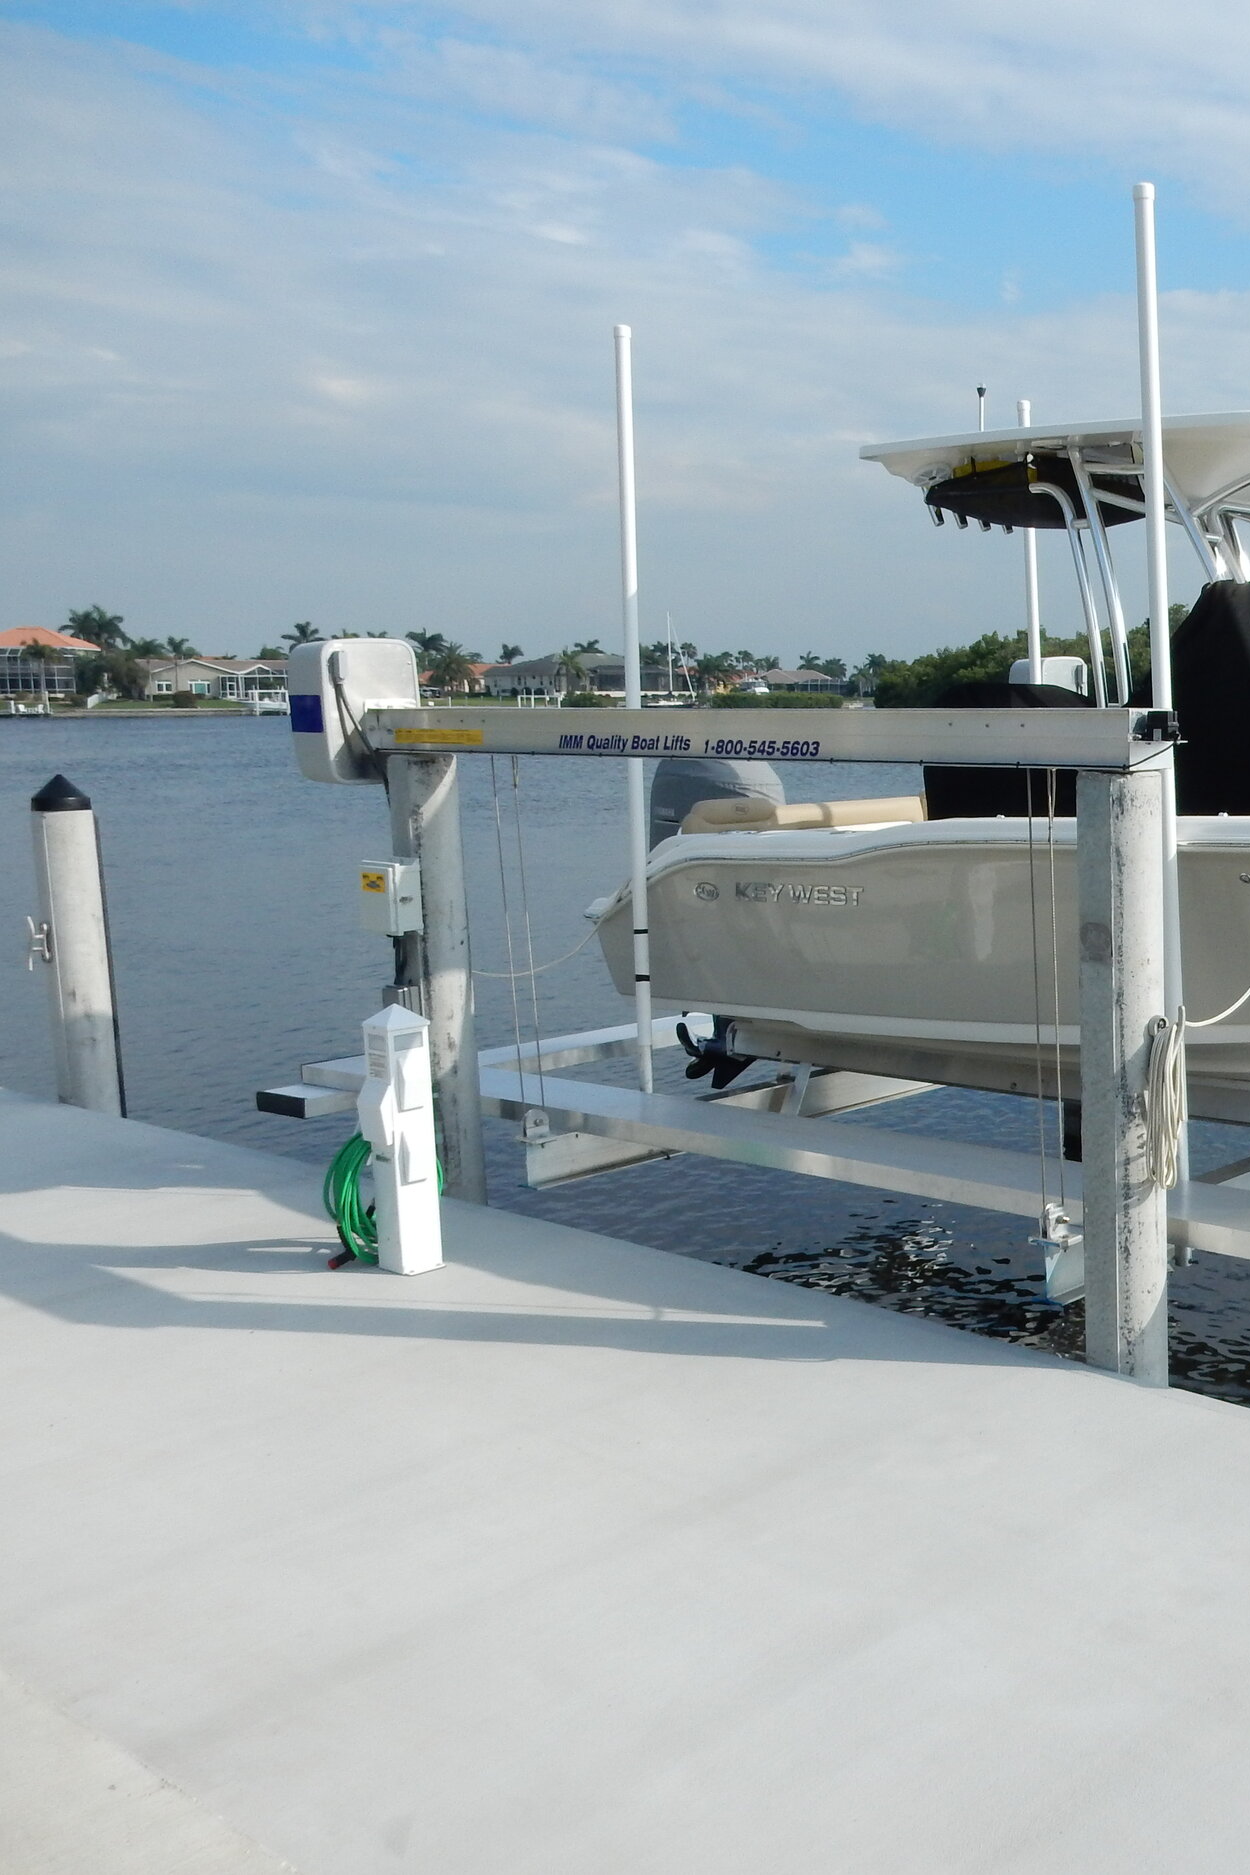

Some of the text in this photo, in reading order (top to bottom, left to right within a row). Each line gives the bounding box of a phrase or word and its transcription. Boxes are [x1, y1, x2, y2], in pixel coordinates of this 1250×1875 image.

[559, 734, 820, 757] IMM Quality Boat Lifts 1-800-545-5603
